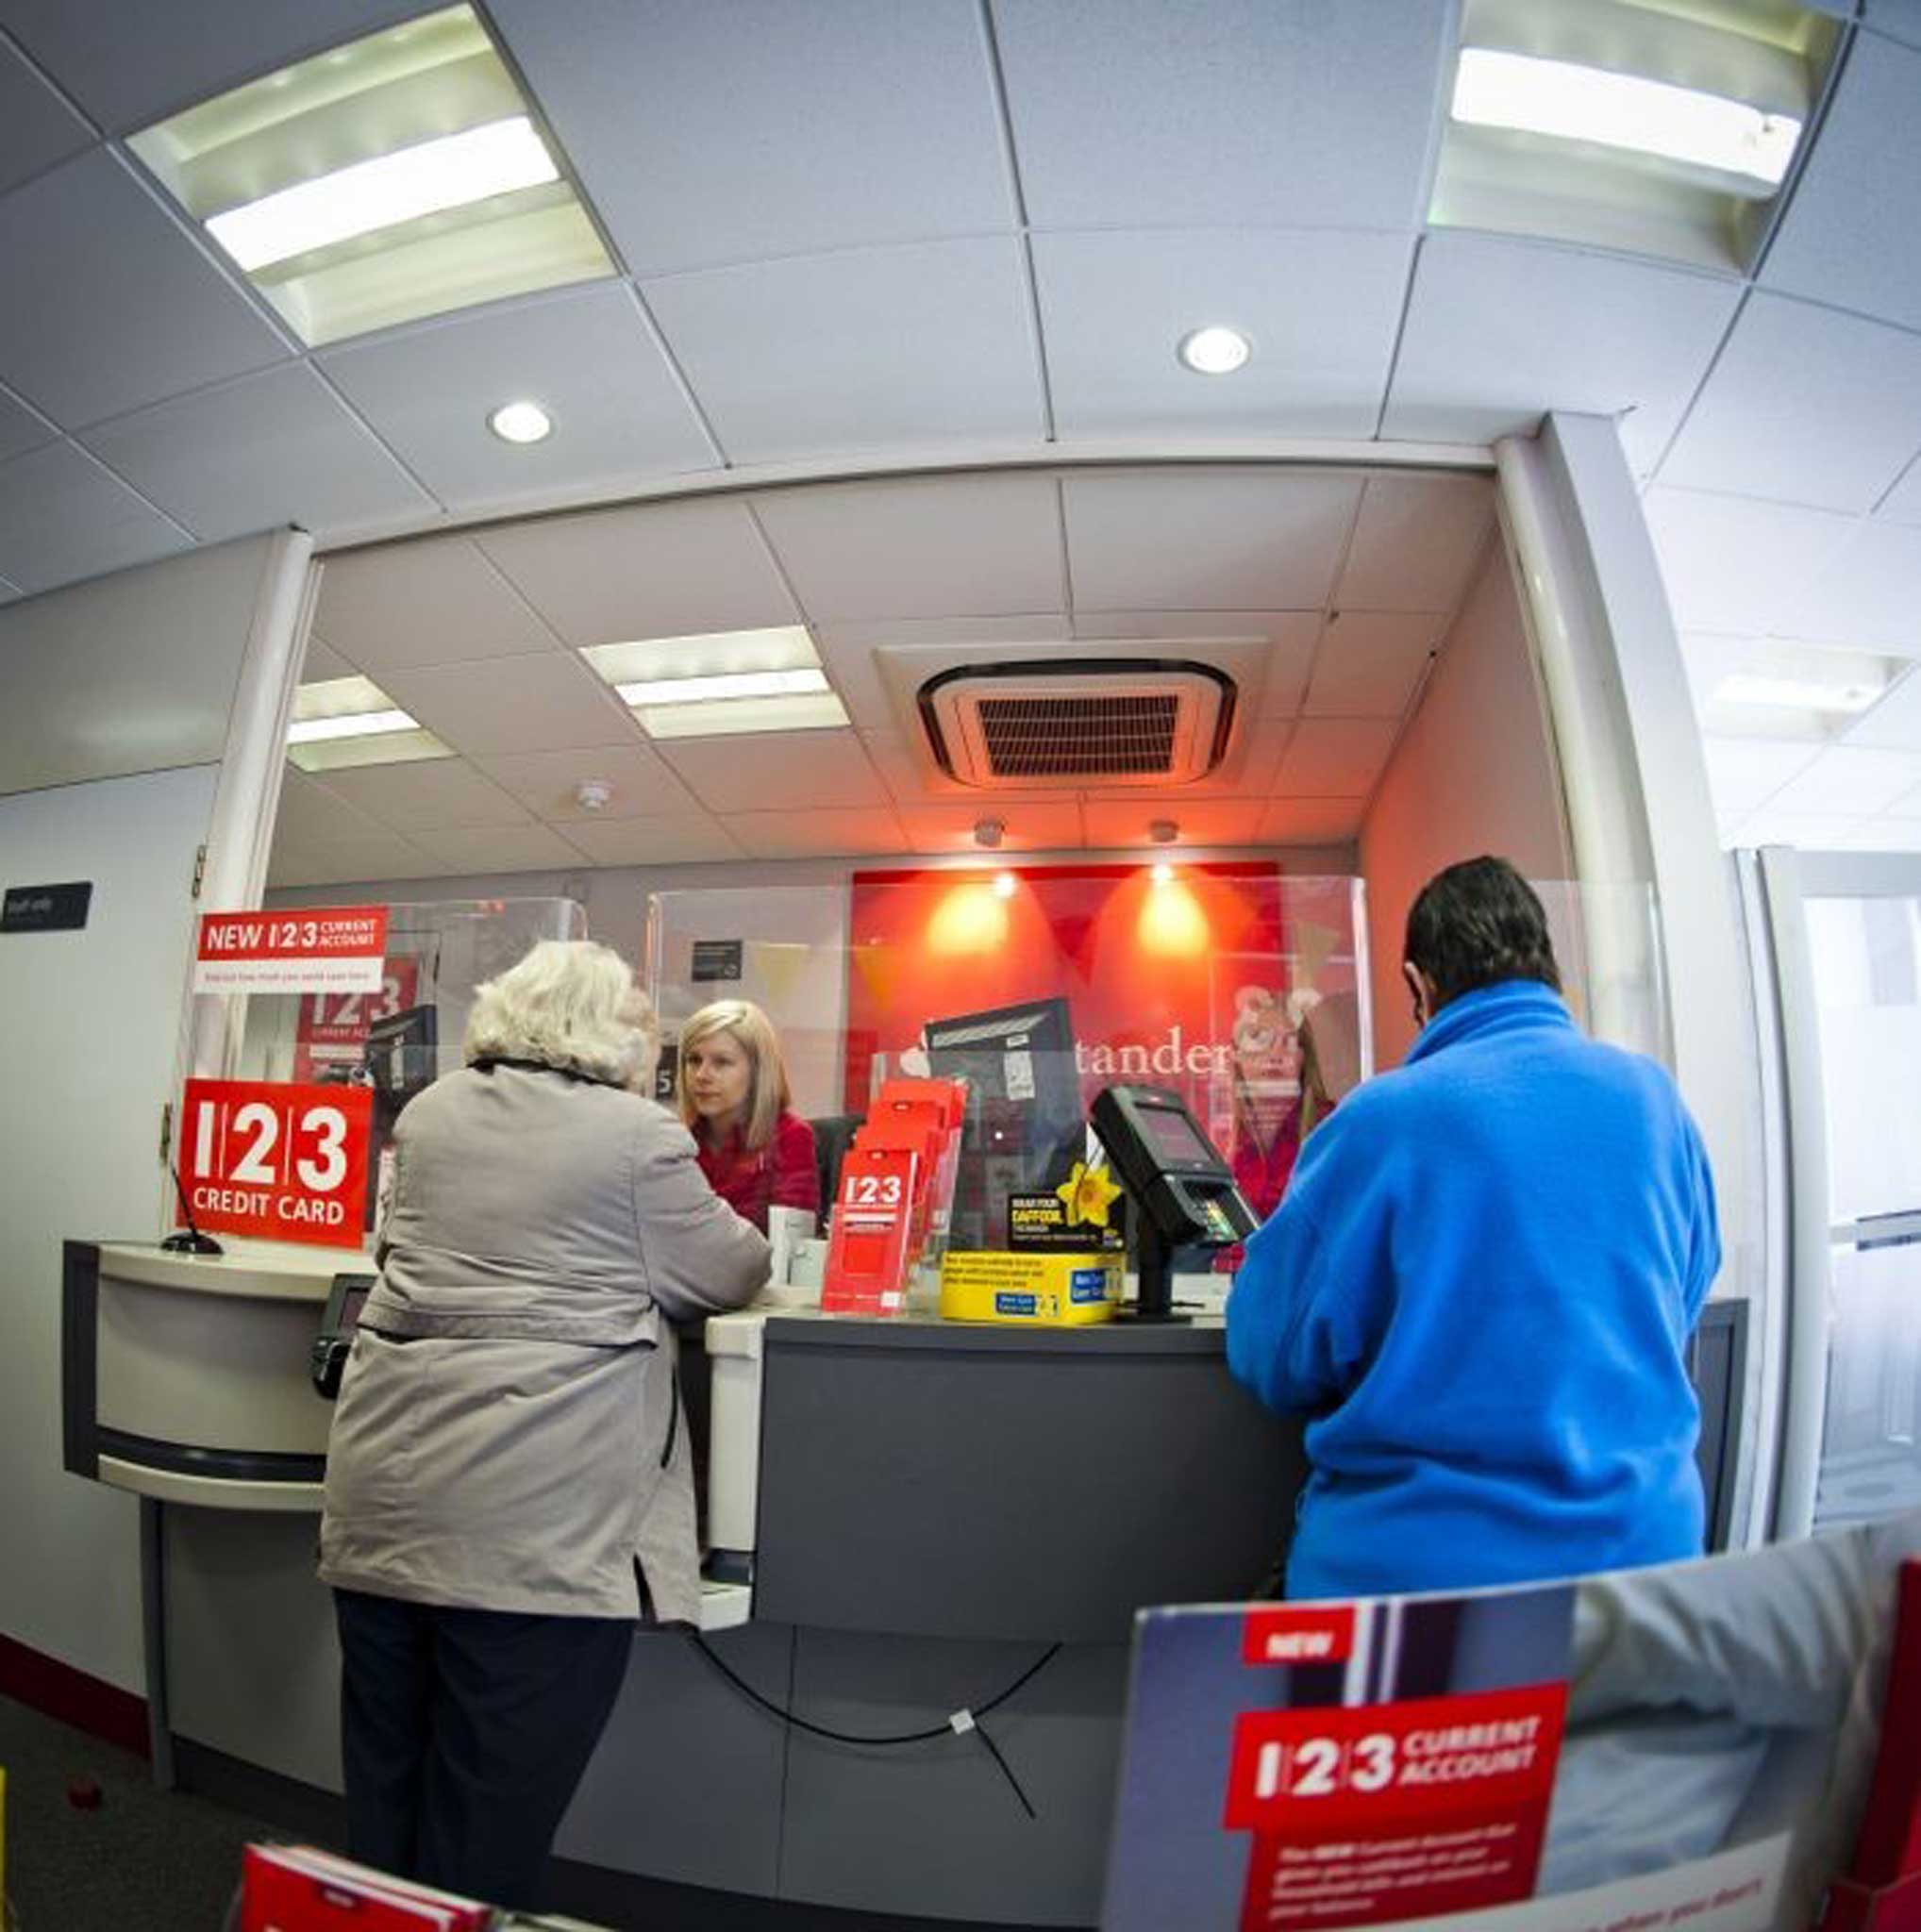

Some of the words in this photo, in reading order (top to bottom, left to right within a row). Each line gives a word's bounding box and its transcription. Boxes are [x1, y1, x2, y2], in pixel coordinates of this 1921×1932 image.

[208, 923, 263, 950] NEW
[321, 918, 376, 933] CURRENT
[317, 932, 375, 946] ACCOUNT
[1074, 1026, 1230, 1074] tander
[193, 1187, 271, 1217] CREDIT
[278, 1196, 344, 1225] CARD
[1265, 1631, 1335, 1659] NEW
[1402, 1714, 1542, 1757] CURRENT
[1397, 1744, 1538, 1786] ACCOUNT
